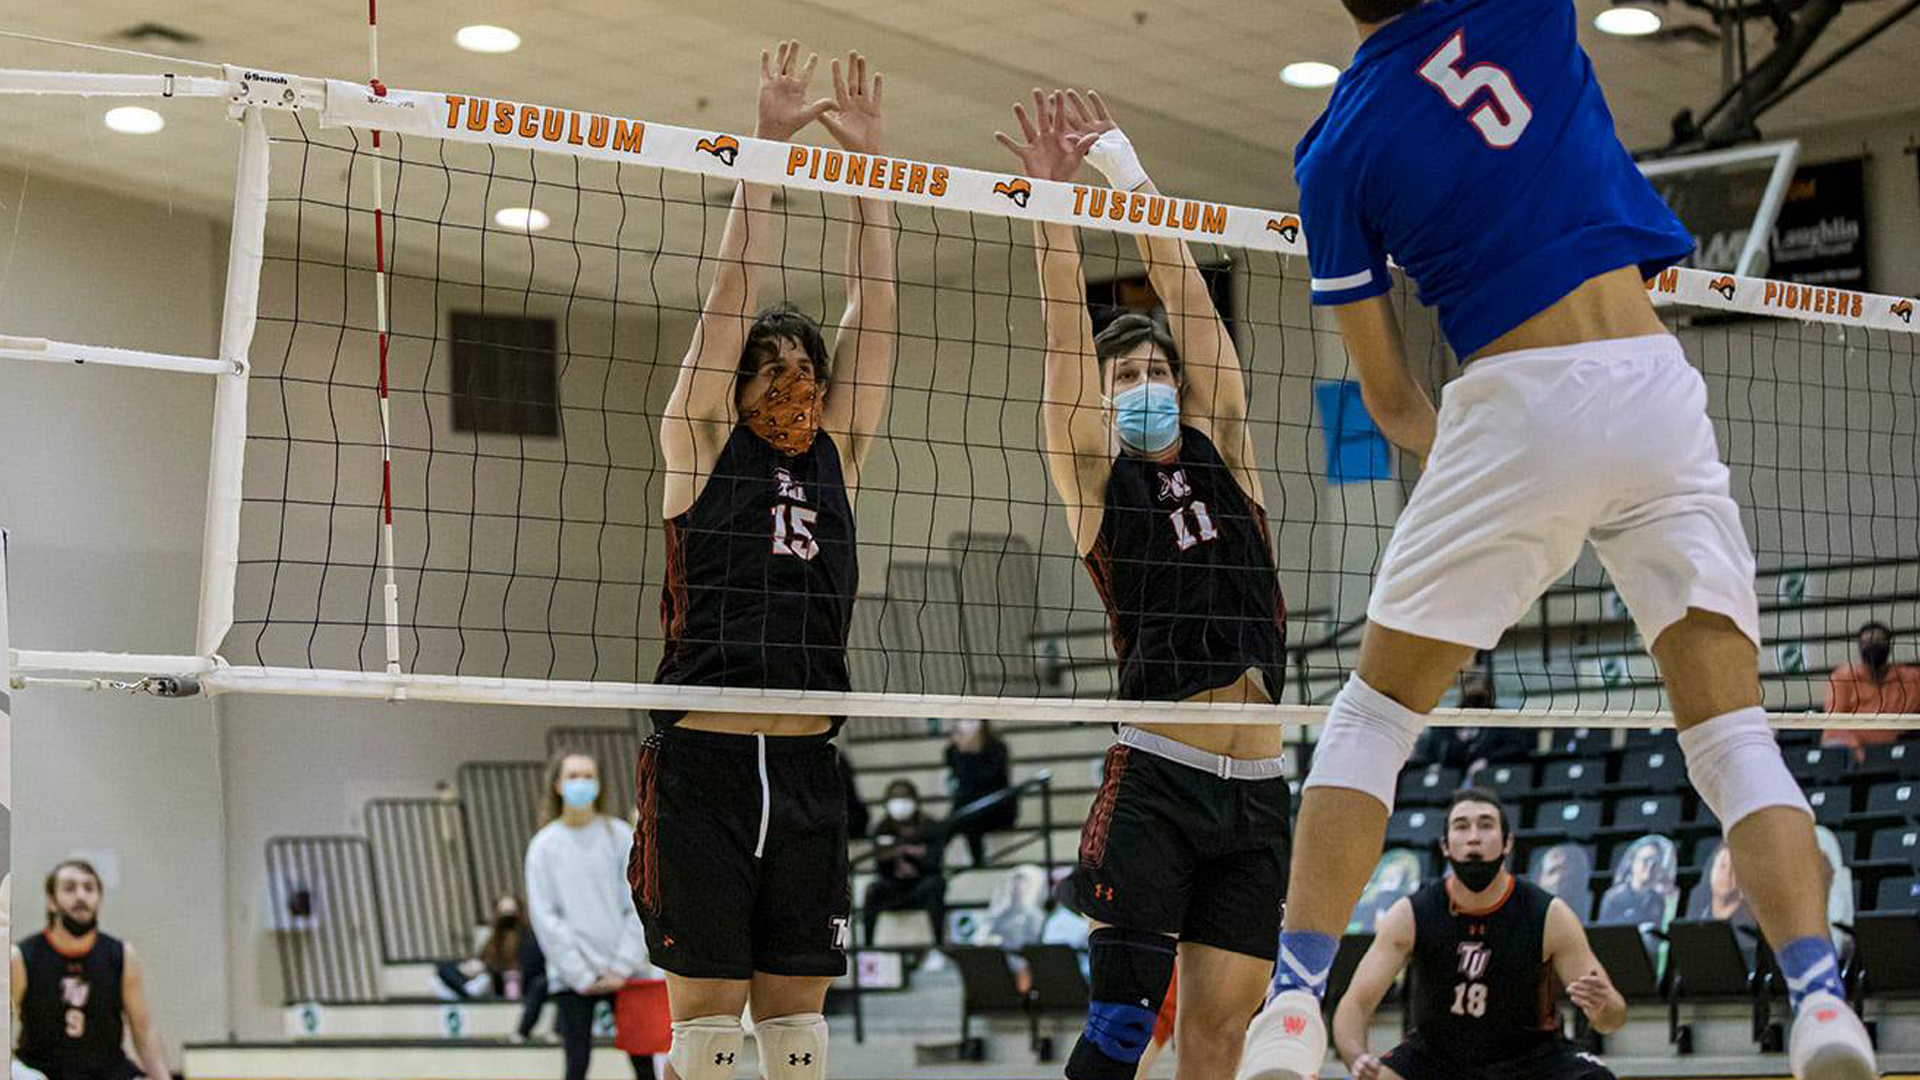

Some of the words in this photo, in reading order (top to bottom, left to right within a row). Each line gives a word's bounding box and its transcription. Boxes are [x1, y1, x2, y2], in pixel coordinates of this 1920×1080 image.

[252, 73, 288, 86] Senoh
[1415, 27, 1533, 150] 5
[445, 94, 645, 154] TUSCULUM
[786, 145, 950, 197] PIONEERS
[1072, 186, 1228, 235] TUSCULUM
[1764, 281, 1863, 318] PIONEERS
[769, 503, 820, 561] 15
[1169, 500, 1218, 552] 11
[1457, 941, 1492, 979] TU
[1450, 982, 1488, 1018] 18
[65, 1008, 85, 1038] 9
